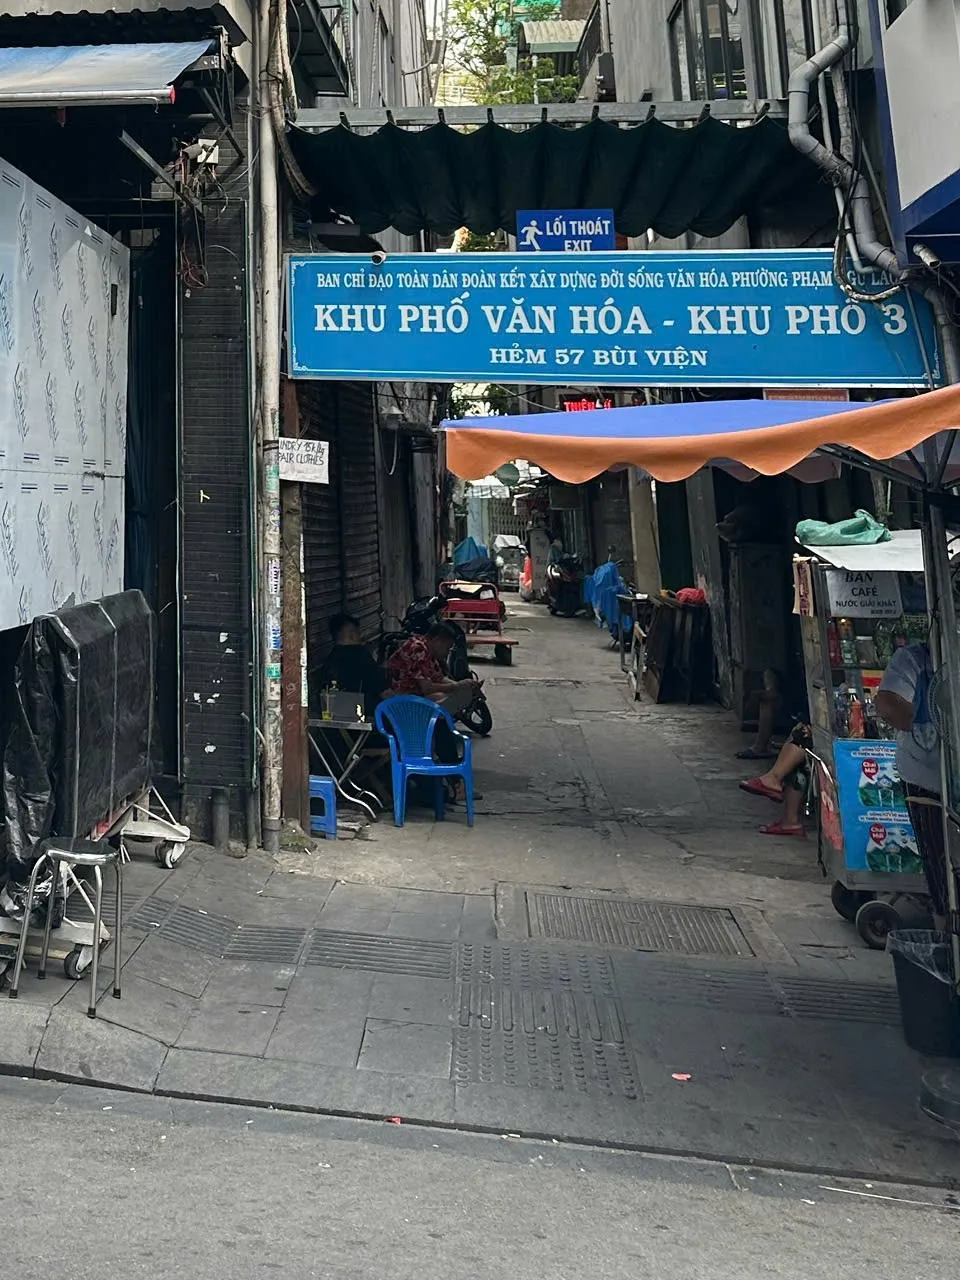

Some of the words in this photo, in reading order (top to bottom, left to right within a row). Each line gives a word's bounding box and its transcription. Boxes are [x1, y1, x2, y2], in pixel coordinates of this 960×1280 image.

[545, 216, 567, 236] LỐI
[569, 215, 611, 236] THOÁT
[564, 240, 592, 251] EXIT
[317, 274, 340, 288] BAN
[344, 268, 365, 288] CHỈ
[369, 273, 393, 291] ĐẠO
[396, 269, 429, 288] TOÀN
[433, 270, 459, 288] DÂN
[462, 269, 496, 288] ĐOÀN
[500, 267, 526, 288] KẾT
[530, 269, 556, 288] XÂY
[560, 272, 597, 291] DỰNG
[601, 269, 624, 288] ĐỜI
[628, 266, 664, 288] SỐNG
[668, 269, 695, 288] VĂN
[700, 268, 728, 288] HÓA
[732, 268, 788, 288] PHƯỜNG
[792, 271, 834, 291] PHẠM
[314, 304, 386, 332] KHU
[398, 292, 470, 333] PHỐ
[481, 297, 557, 334] VĂN
[569, 297, 652, 335] HÓA
[688, 305, 771, 335] KHU
[883, 303, 907, 335] 3
[489, 342, 546, 364] HẺM
[555, 349, 584, 365] 57
[593, 345, 637, 366] BÙI
[645, 345, 708, 369] VIỆN
[280, 440, 302, 452] UNDRY
[279, 452, 295, 464] PAIR
[296, 453, 324, 466] CLOTHES
[851, 585, 879, 597] CAFÉ
[836, 599, 859, 608] NƯỚC
